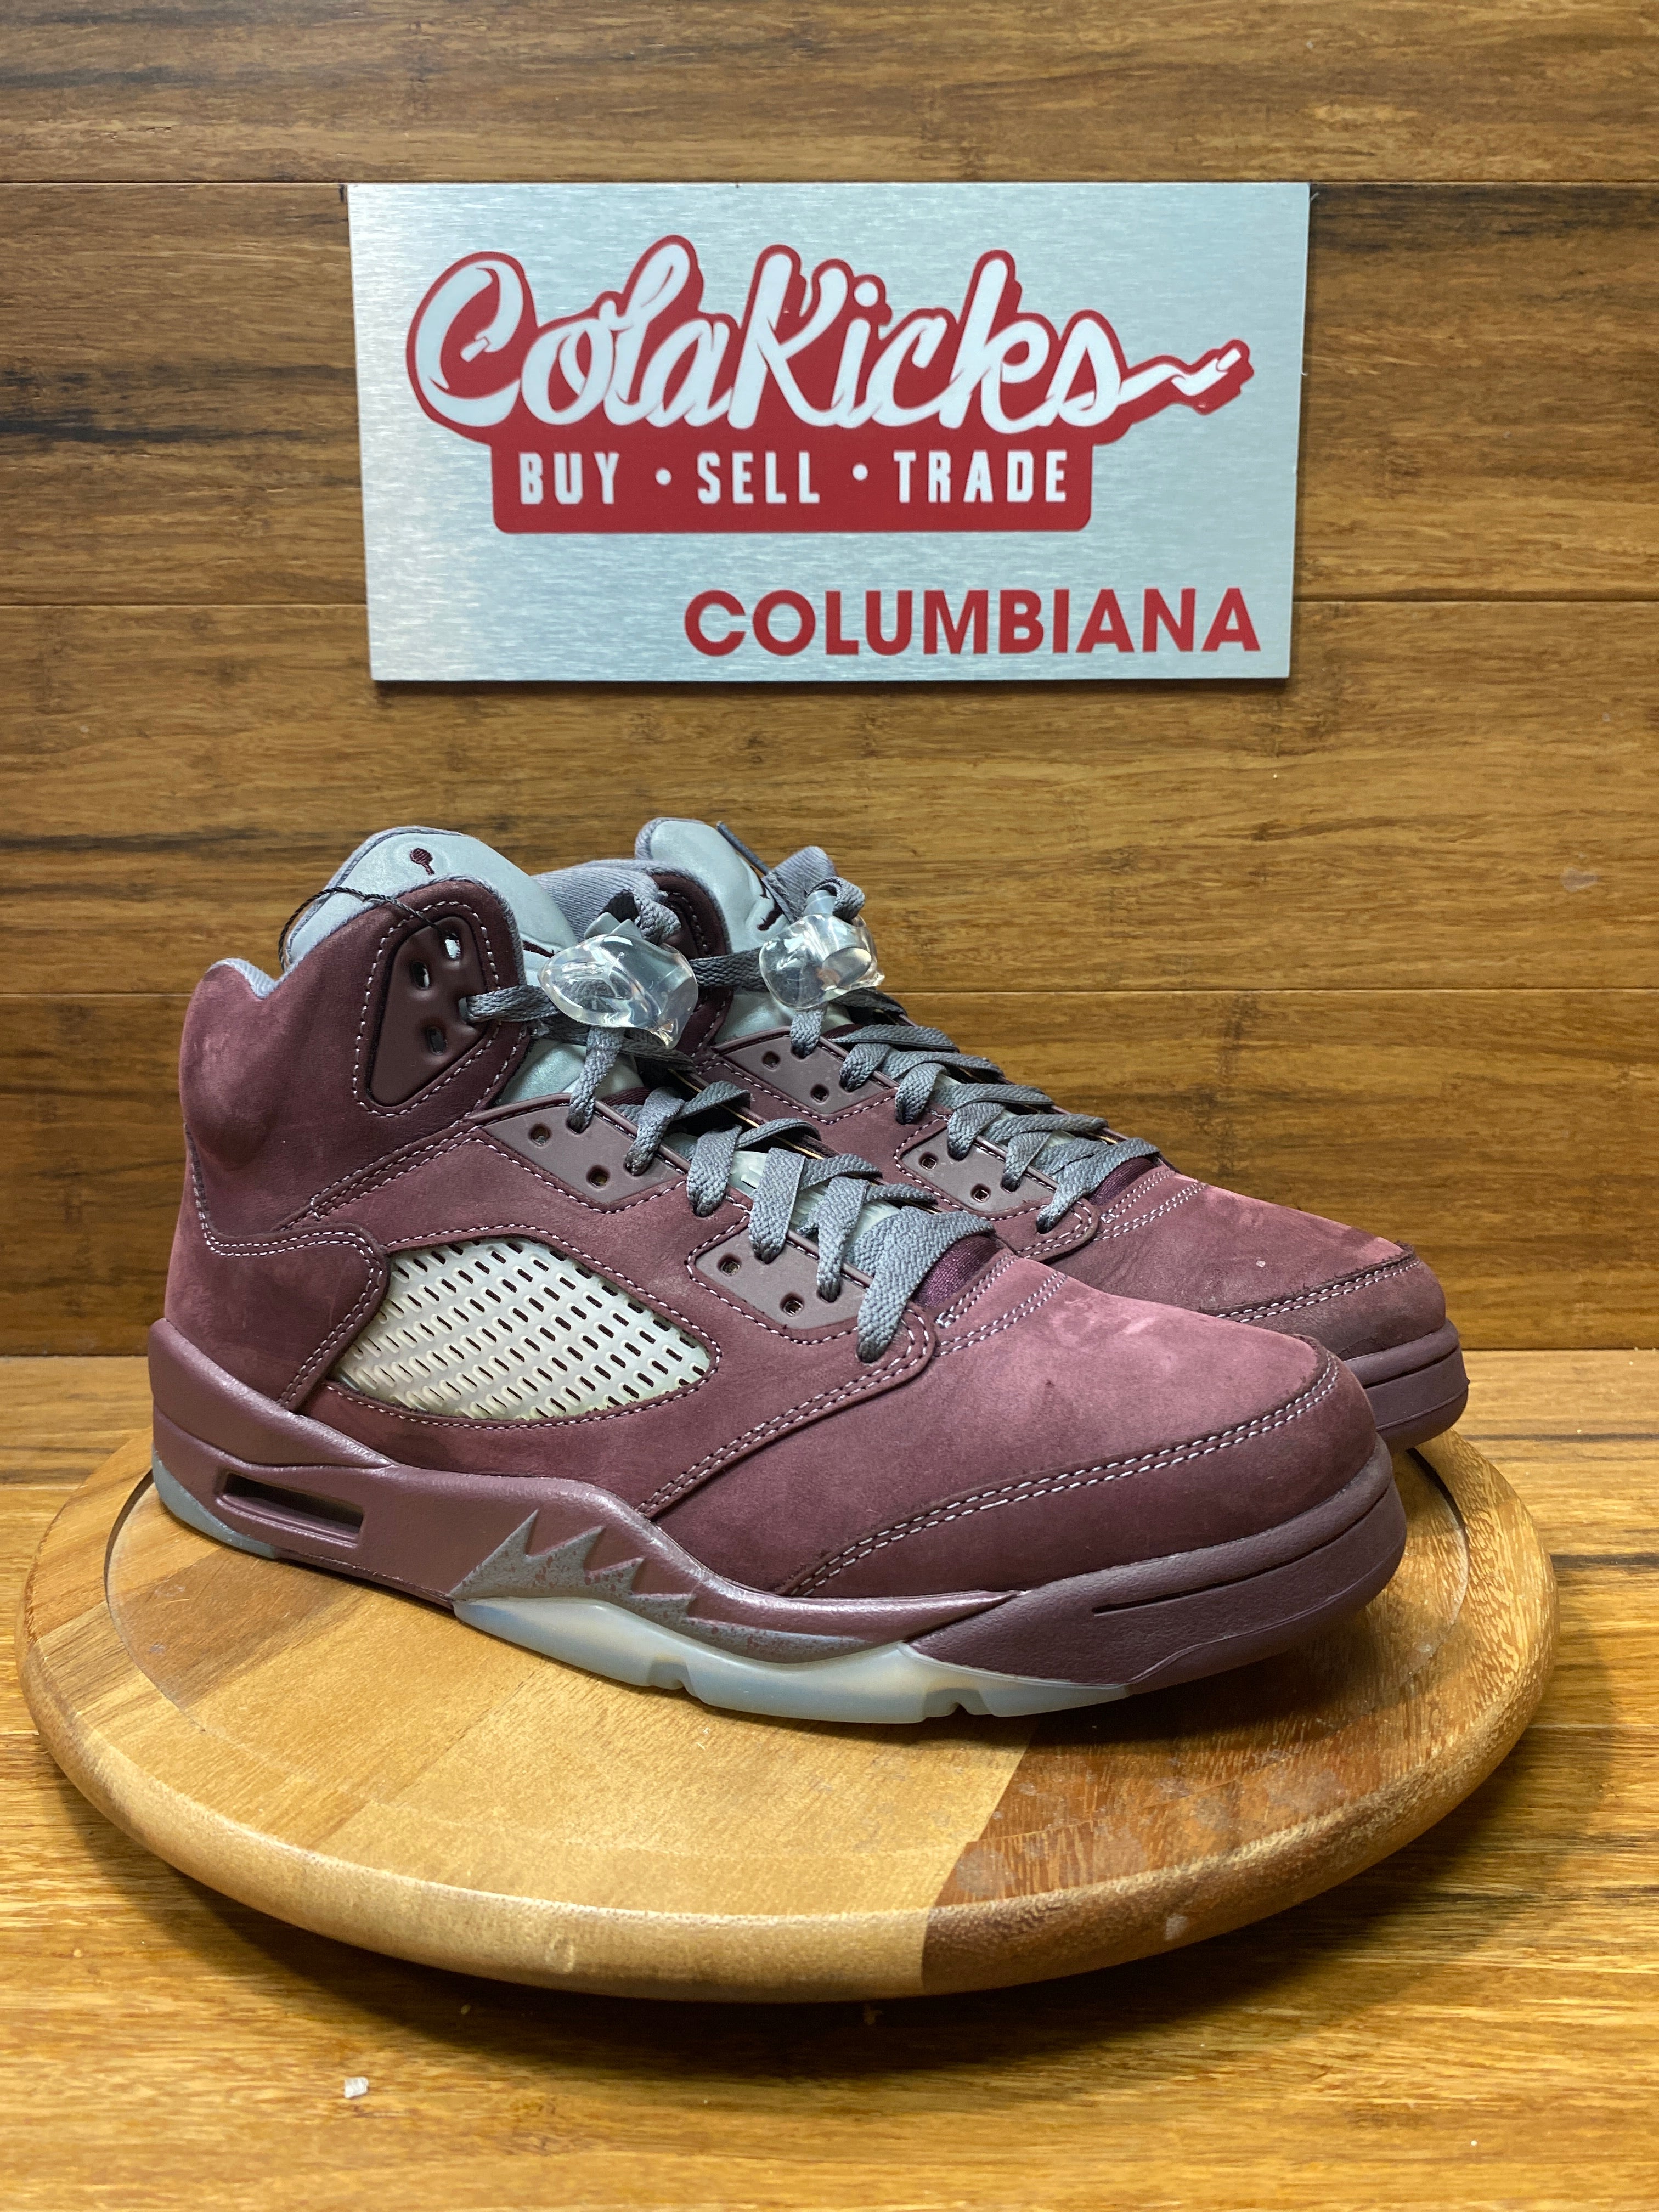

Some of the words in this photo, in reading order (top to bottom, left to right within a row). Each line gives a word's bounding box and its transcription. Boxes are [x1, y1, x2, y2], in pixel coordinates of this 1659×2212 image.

[413, 241, 1242, 435] ColaKicks
[518, 451, 620, 505] BUY
[696, 450, 820, 505] SELL
[893, 449, 1068, 504] TRADE
[685, 588, 1259, 655] COLUMBIANA
